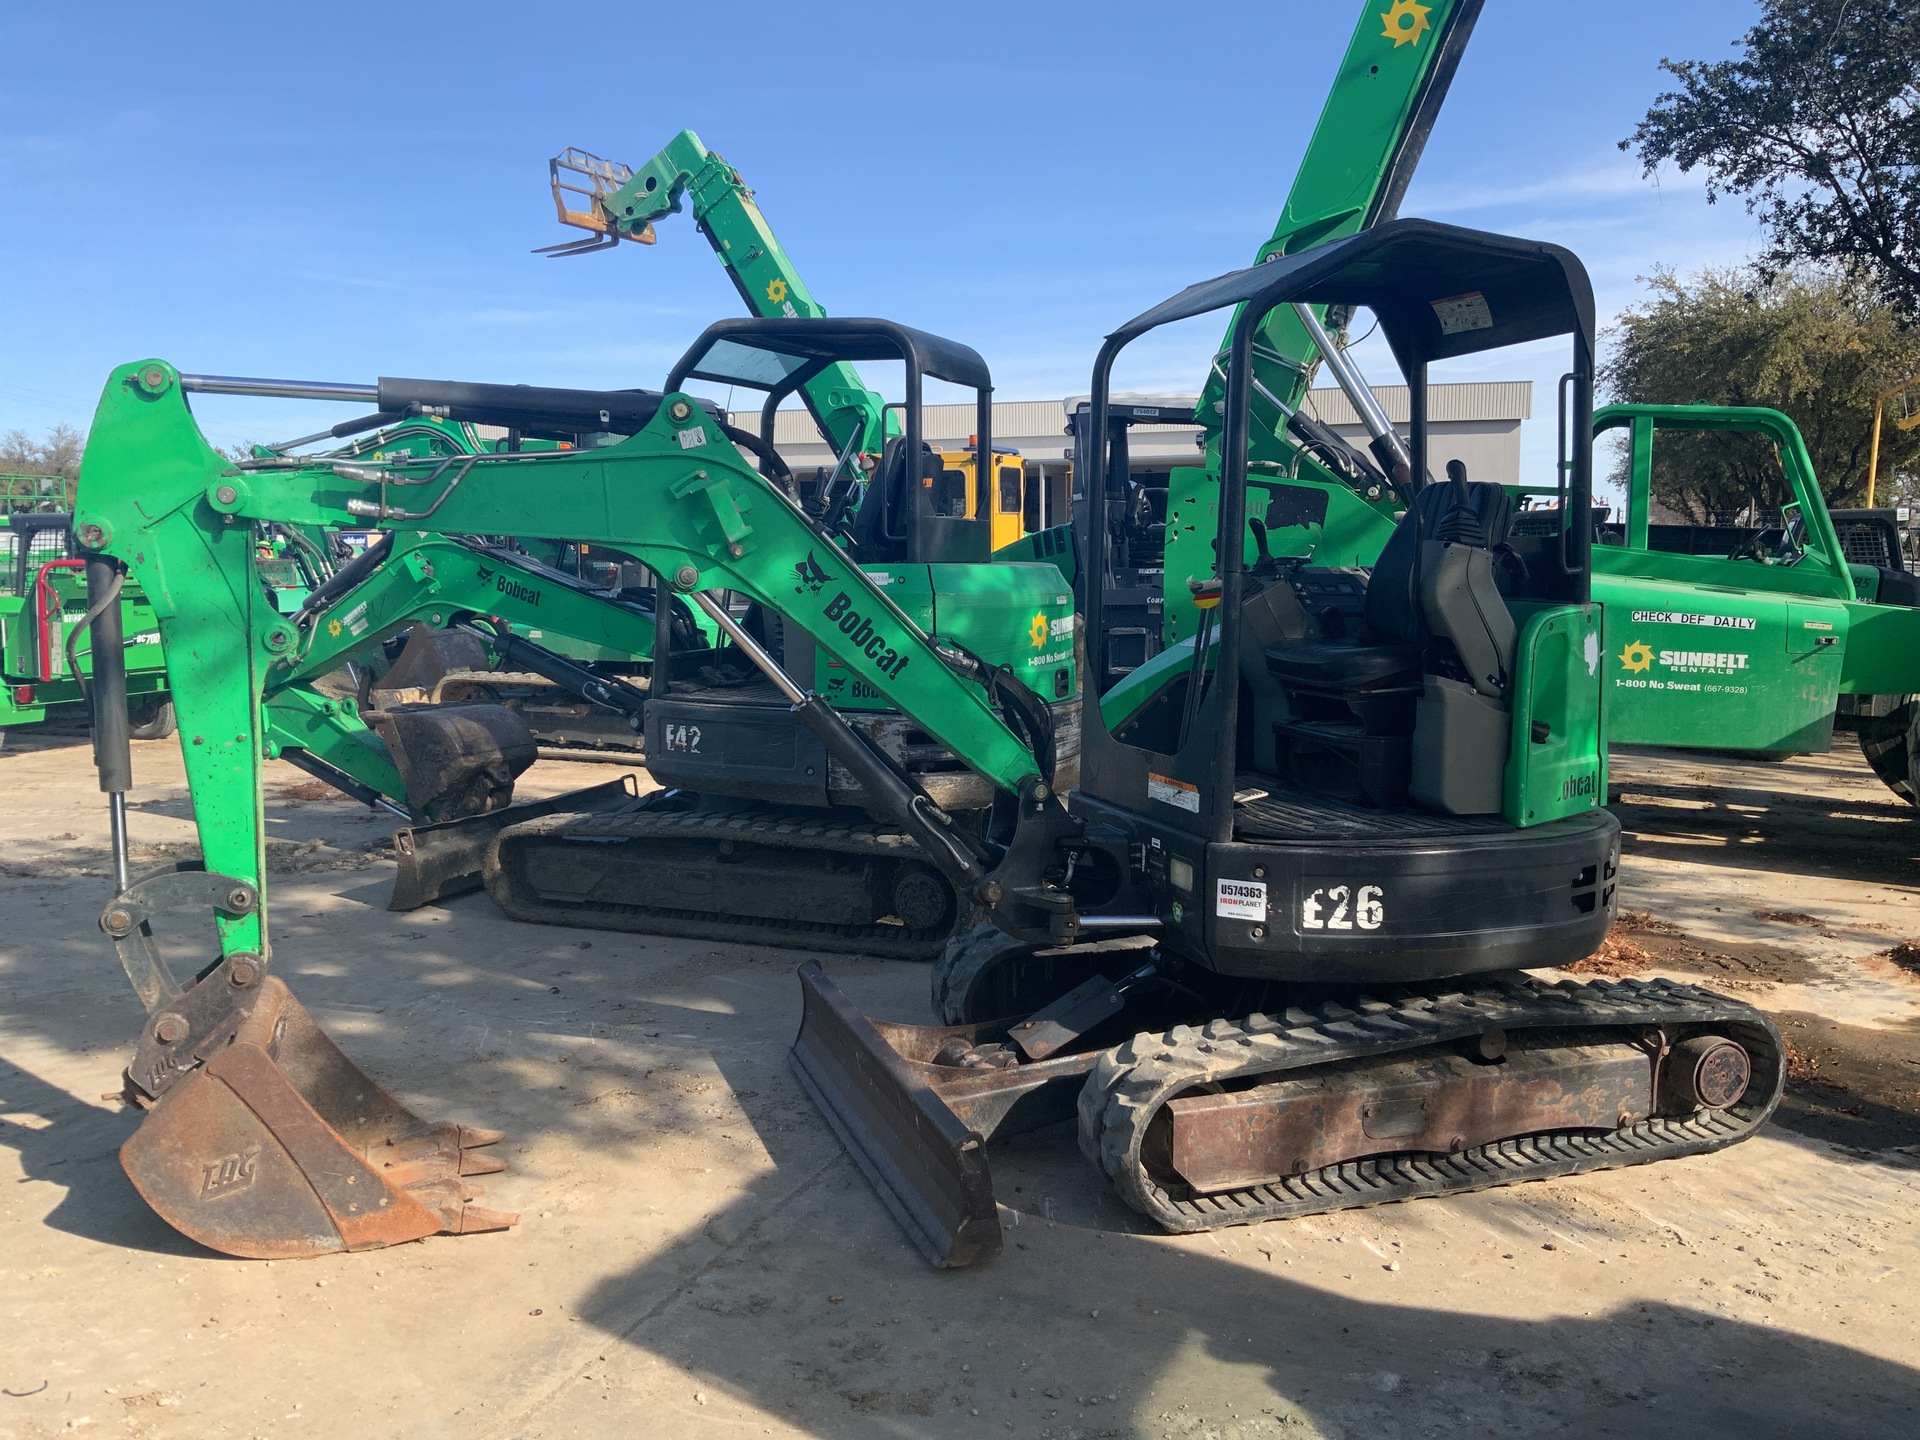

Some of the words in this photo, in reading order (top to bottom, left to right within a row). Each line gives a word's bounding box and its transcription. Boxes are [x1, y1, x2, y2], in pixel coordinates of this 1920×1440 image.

[496, 575, 541, 606] Bobcat
[1632, 611, 1673, 622] CHECK
[1681, 614, 1705, 625] DEF
[1714, 617, 1755, 628] DAILY
[823, 590, 910, 681] Bobcat
[1028, 655, 1046, 666] 1-800
[1046, 653, 1054, 663] No
[1659, 650, 1748, 669] SUNBELT
[1671, 666, 1734, 675] RENTALS
[1615, 679, 1647, 689] 1-800
[1649, 680, 1665, 690] No
[1667, 681, 1701, 692] Sweat
[1704, 684, 1748, 694] (667-9328)
[666, 724, 701, 753] E42
[1562, 770, 1596, 801] obcat
[1221, 884, 1262, 899] U574363
[1303, 885, 1383, 929] E26
[201, 1150, 260, 1201] TAG
